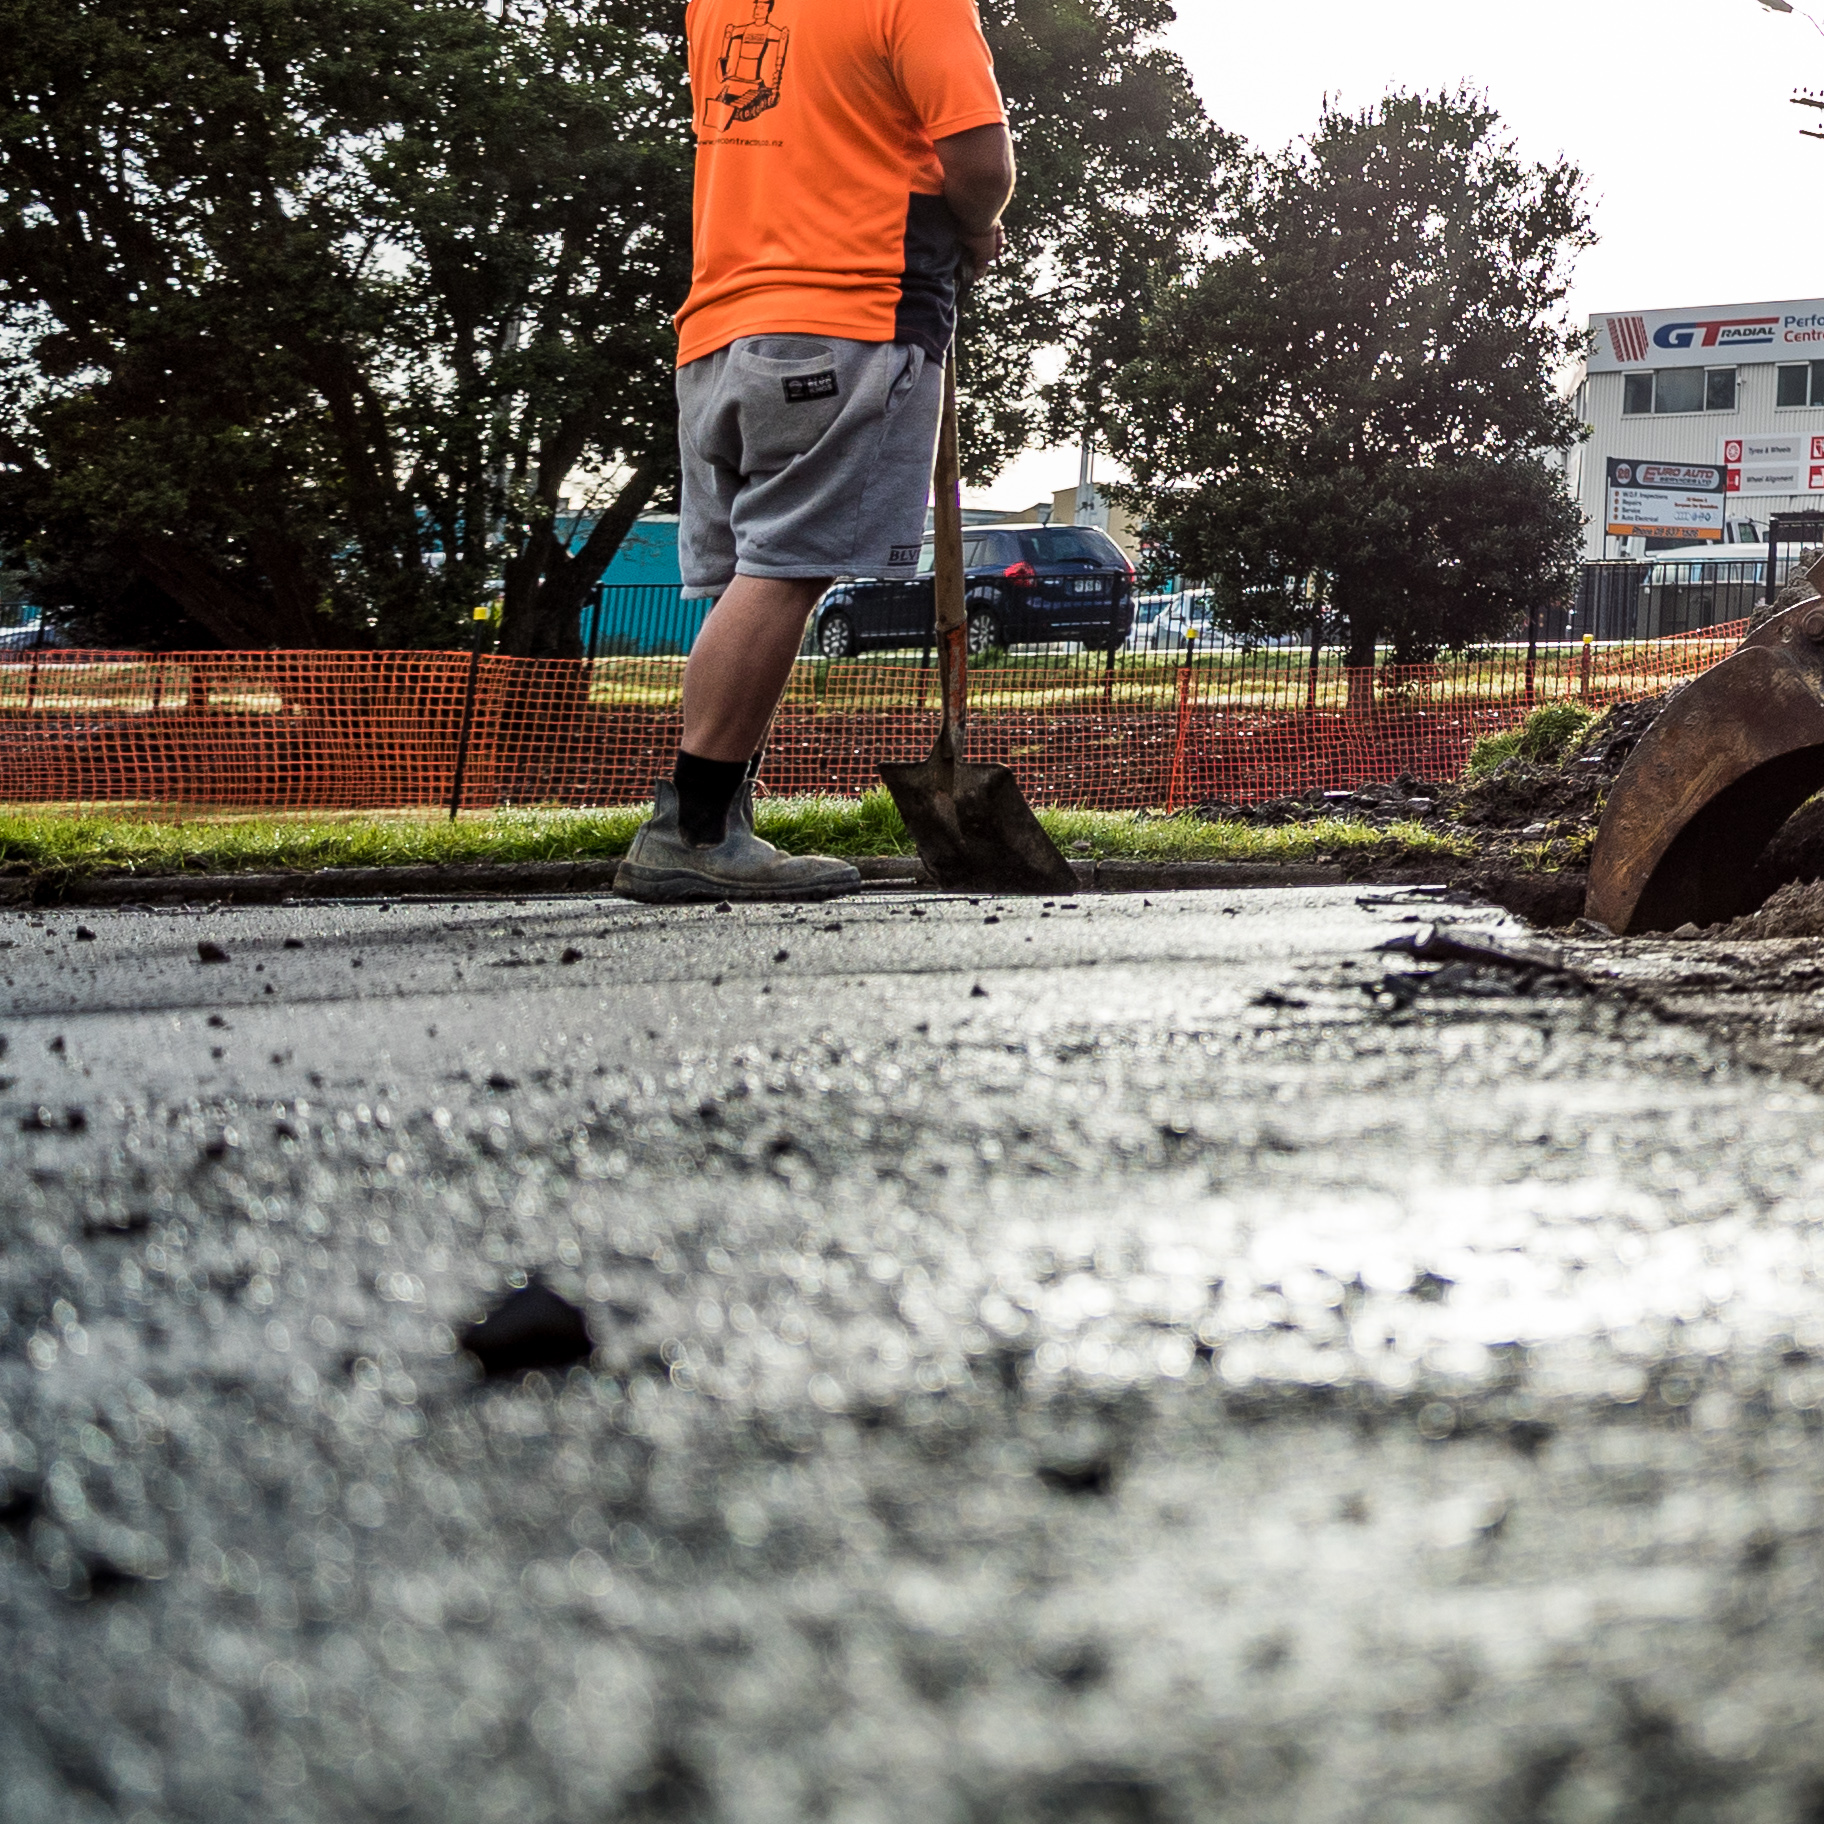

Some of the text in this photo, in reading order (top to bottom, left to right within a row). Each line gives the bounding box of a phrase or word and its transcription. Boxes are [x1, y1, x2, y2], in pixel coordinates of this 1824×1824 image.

[1653, 317, 1780, 348] GT RADIAL
[1749, 447, 1763, 456] Tyres
[1643, 466, 1680, 482] EURO
[1683, 469, 1714, 479] AUTO
[1765, 475, 1793, 484] Alignment
[1640, 492, 1668, 500] Inspections
[1632, 526, 1652, 535] Phone
[889, 549, 921, 562] BLV
